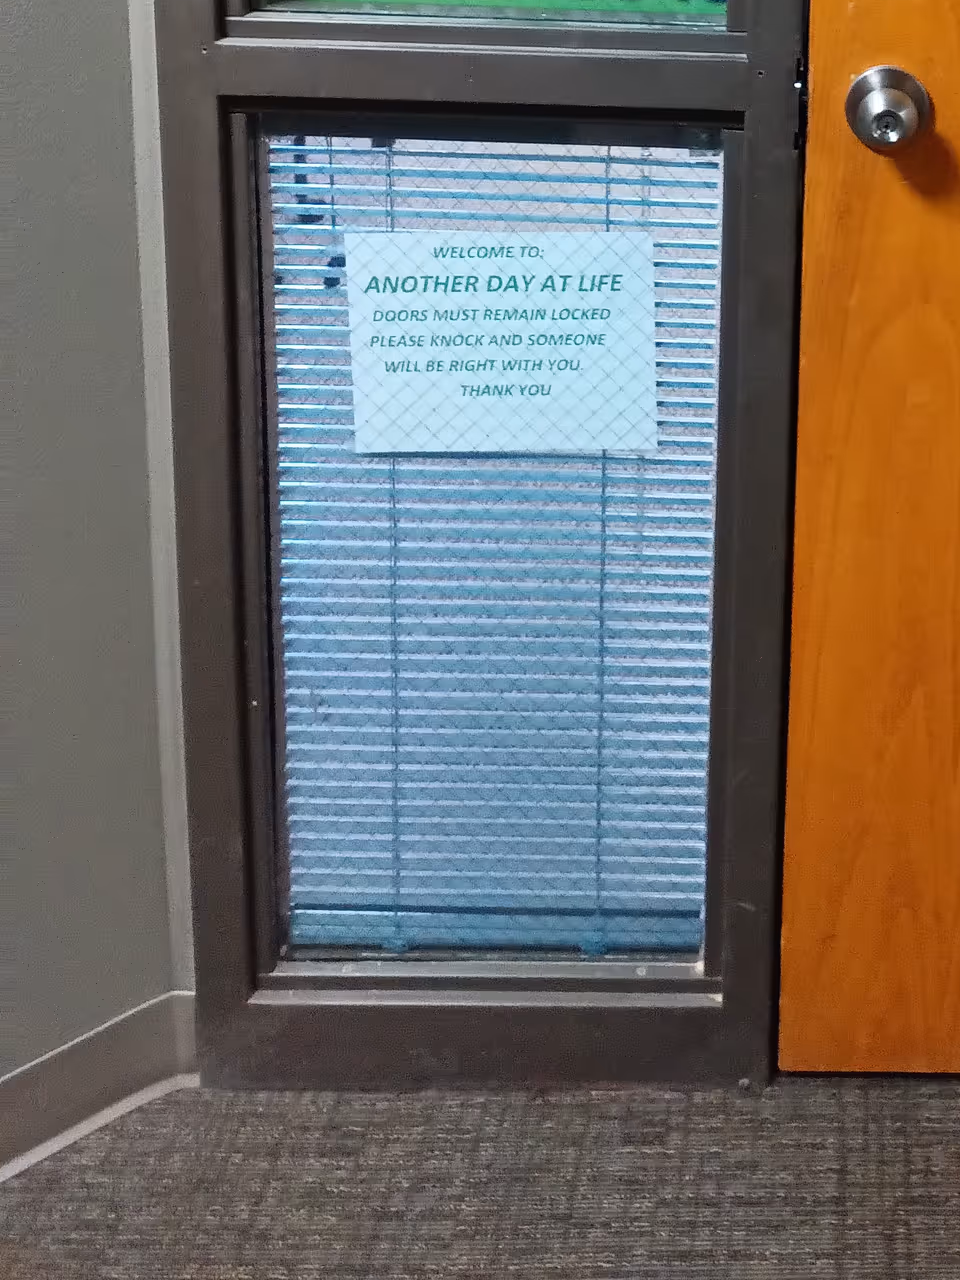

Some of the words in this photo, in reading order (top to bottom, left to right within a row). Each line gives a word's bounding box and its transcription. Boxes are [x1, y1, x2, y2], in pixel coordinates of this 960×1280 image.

[433, 245, 515, 260] WELCOME
[364, 275, 480, 295] ANOTHER
[486, 274, 536, 293] DAY
[540, 274, 574, 293] AT
[578, 274, 624, 292] LIFE
[373, 309, 429, 322] DOORS
[432, 309, 480, 322] MUST
[483, 308, 547, 321] REMAIN
[551, 308, 612, 321] LOCKED
[370, 335, 425, 348] PLEASE
[430, 335, 484, 347] KNOCK
[488, 334, 523, 347] AND
[527, 333, 607, 346] SOMEONE
[385, 360, 421, 373] WILL
[425, 360, 445, 372] BE
[449, 359, 498, 372] RIGHT
[501, 359, 544, 372] WITH
[548, 359, 584, 371] YOU.
[460, 384, 515, 397] THANK
[519, 384, 552, 397] YOU
